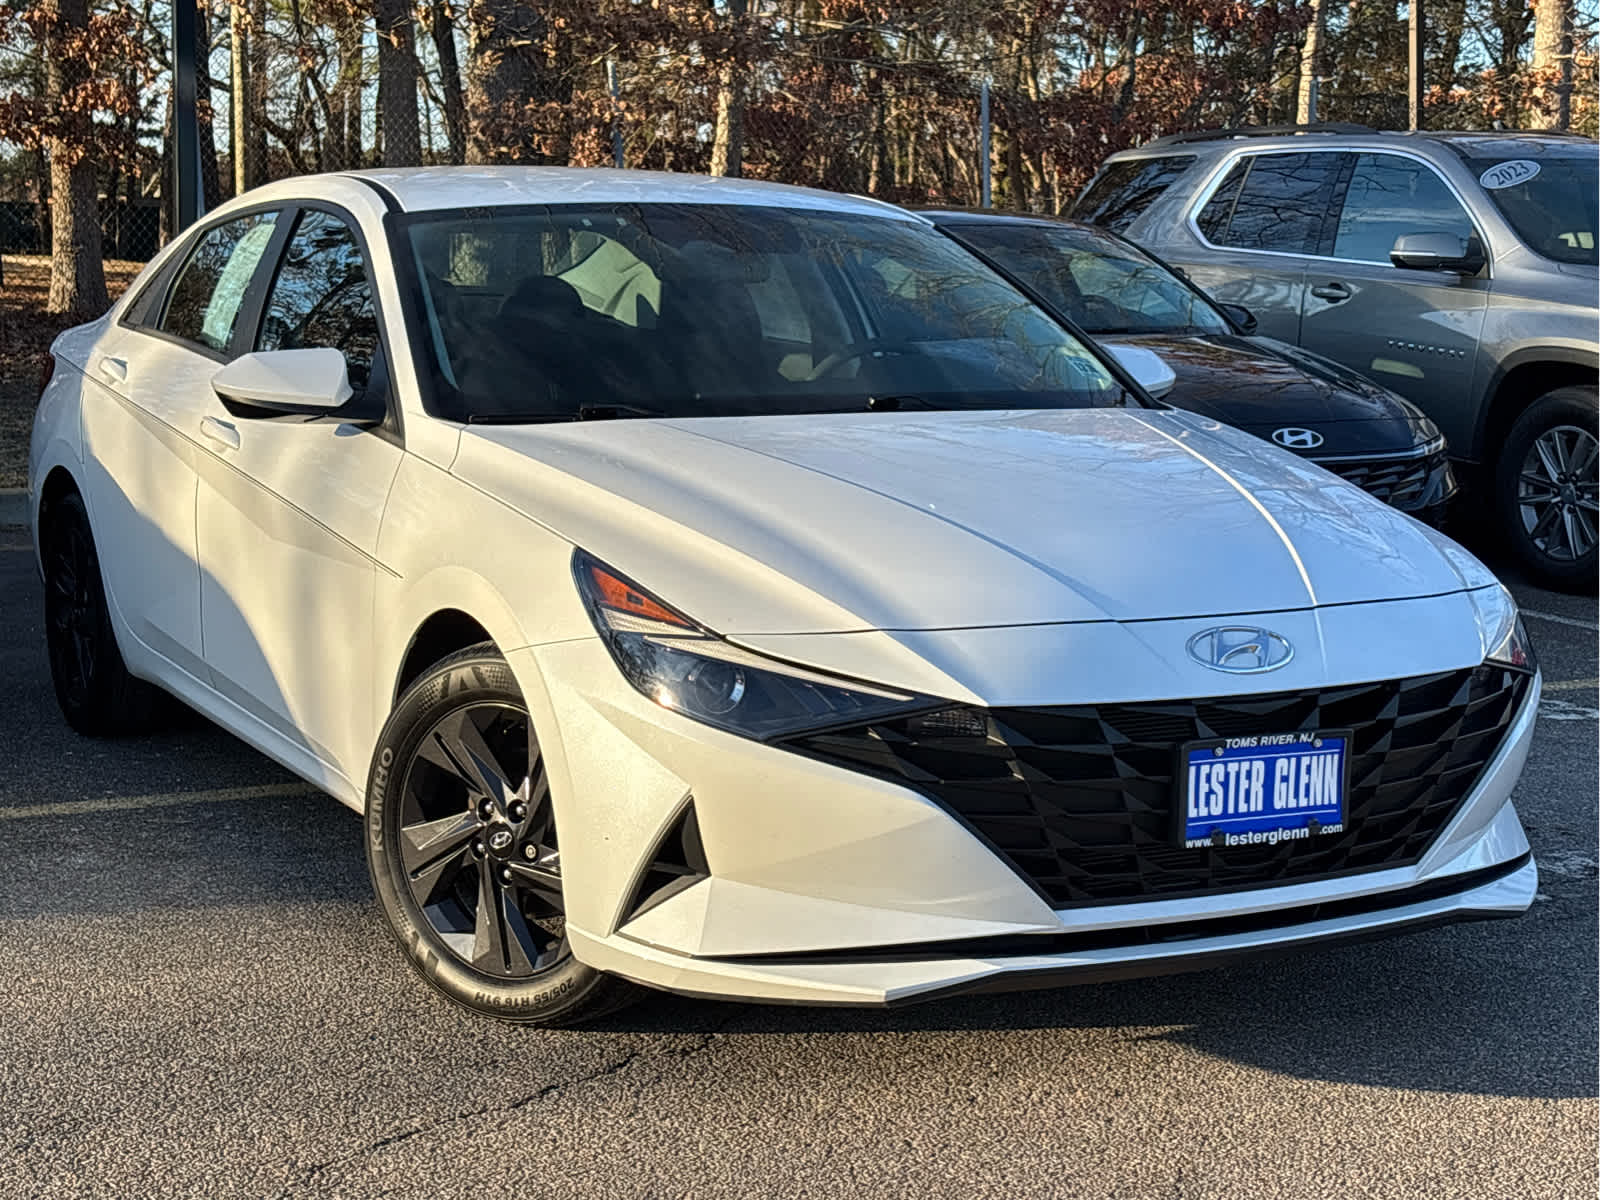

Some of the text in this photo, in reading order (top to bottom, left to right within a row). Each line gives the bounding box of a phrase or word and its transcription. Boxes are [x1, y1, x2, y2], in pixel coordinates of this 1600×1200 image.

[1490, 162, 1530, 186] 2023
[1225, 737, 1257, 749] TOMS
[1299, 732, 1315, 743] NJ
[1188, 753, 1340, 818] LESTER GLENN
[370, 747, 393, 852] KUMHO
[1185, 824, 1343, 848] www. lesterglenn .com
[474, 977, 576, 1008] 205/55 R16 91H
